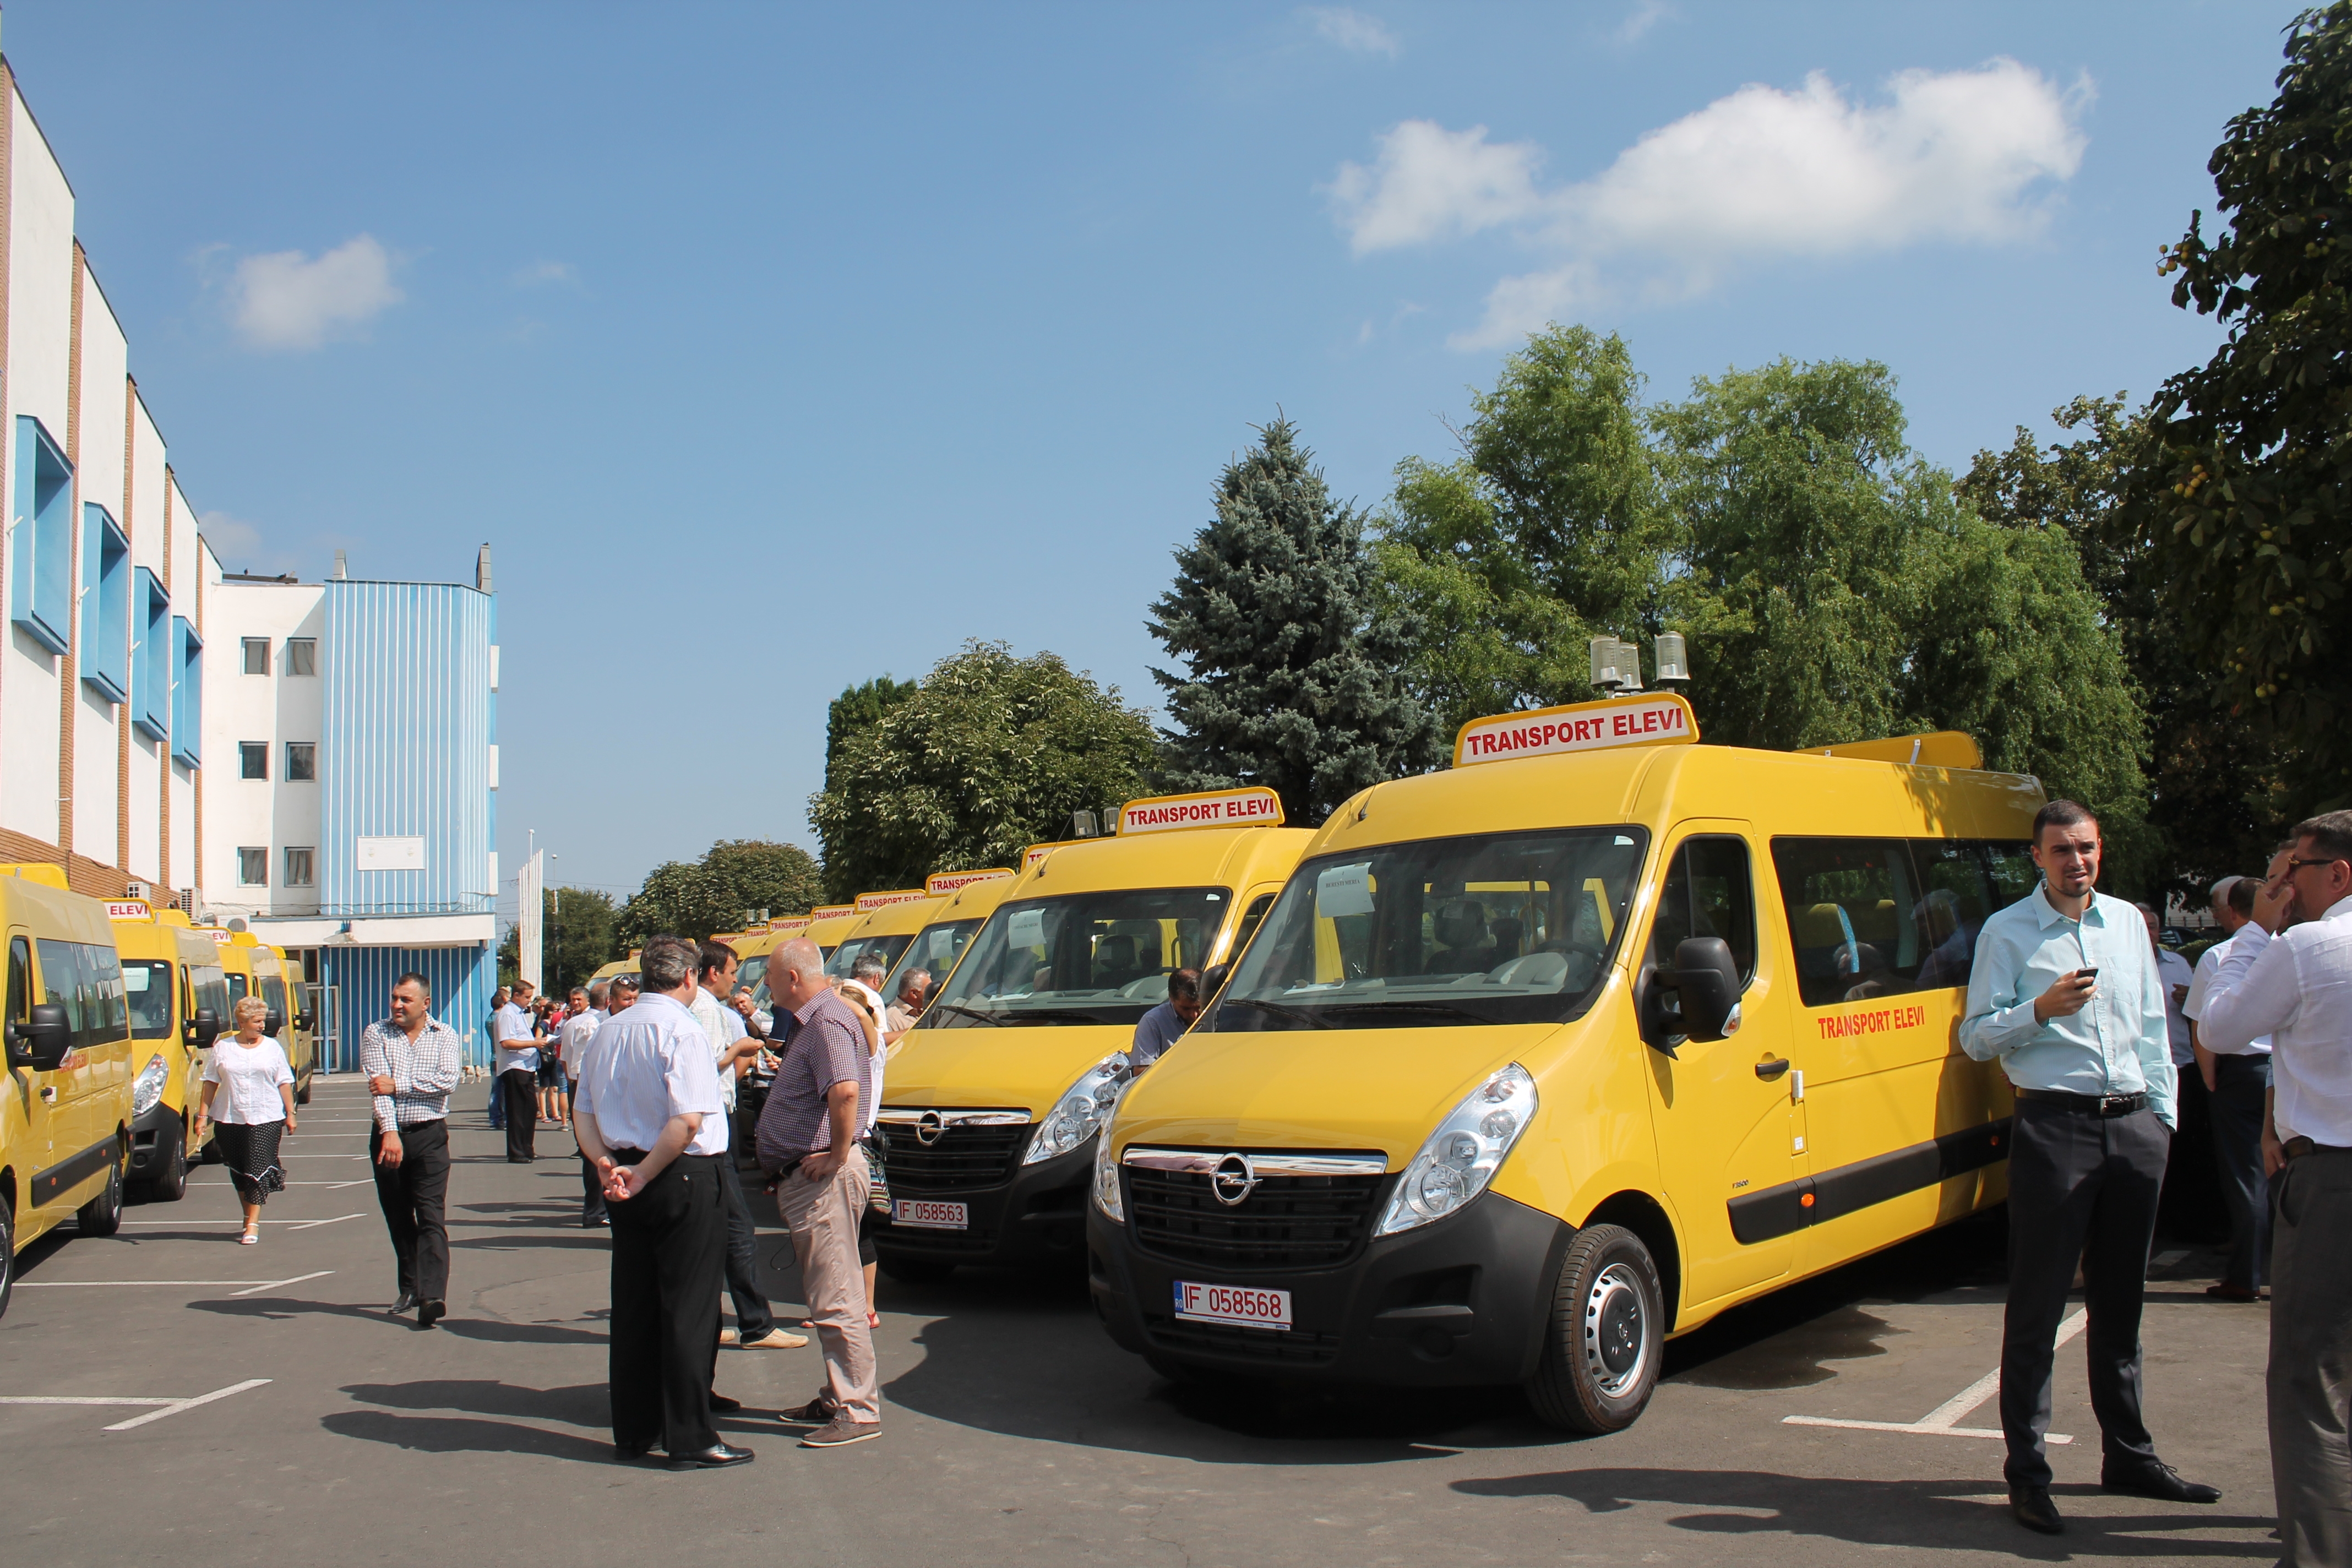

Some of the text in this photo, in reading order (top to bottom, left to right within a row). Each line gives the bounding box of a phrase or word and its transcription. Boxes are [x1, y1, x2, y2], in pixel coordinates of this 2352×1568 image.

[1467, 708, 1683, 755] TRANSPORT ELEVI
[1127, 798, 1274, 826] TRANSPORT ELEVI
[931, 877, 984, 891] TRANSPO
[110, 905, 148, 915] ELEVI
[771, 921, 802, 930] TRANSPORT
[1818, 1005, 1925, 1039] TRANSPORT ELEVI
[899, 1201, 911, 1218] IF
[916, 1202, 963, 1222] 058563
[1175, 1285, 1282, 1318] RO IF 058568
